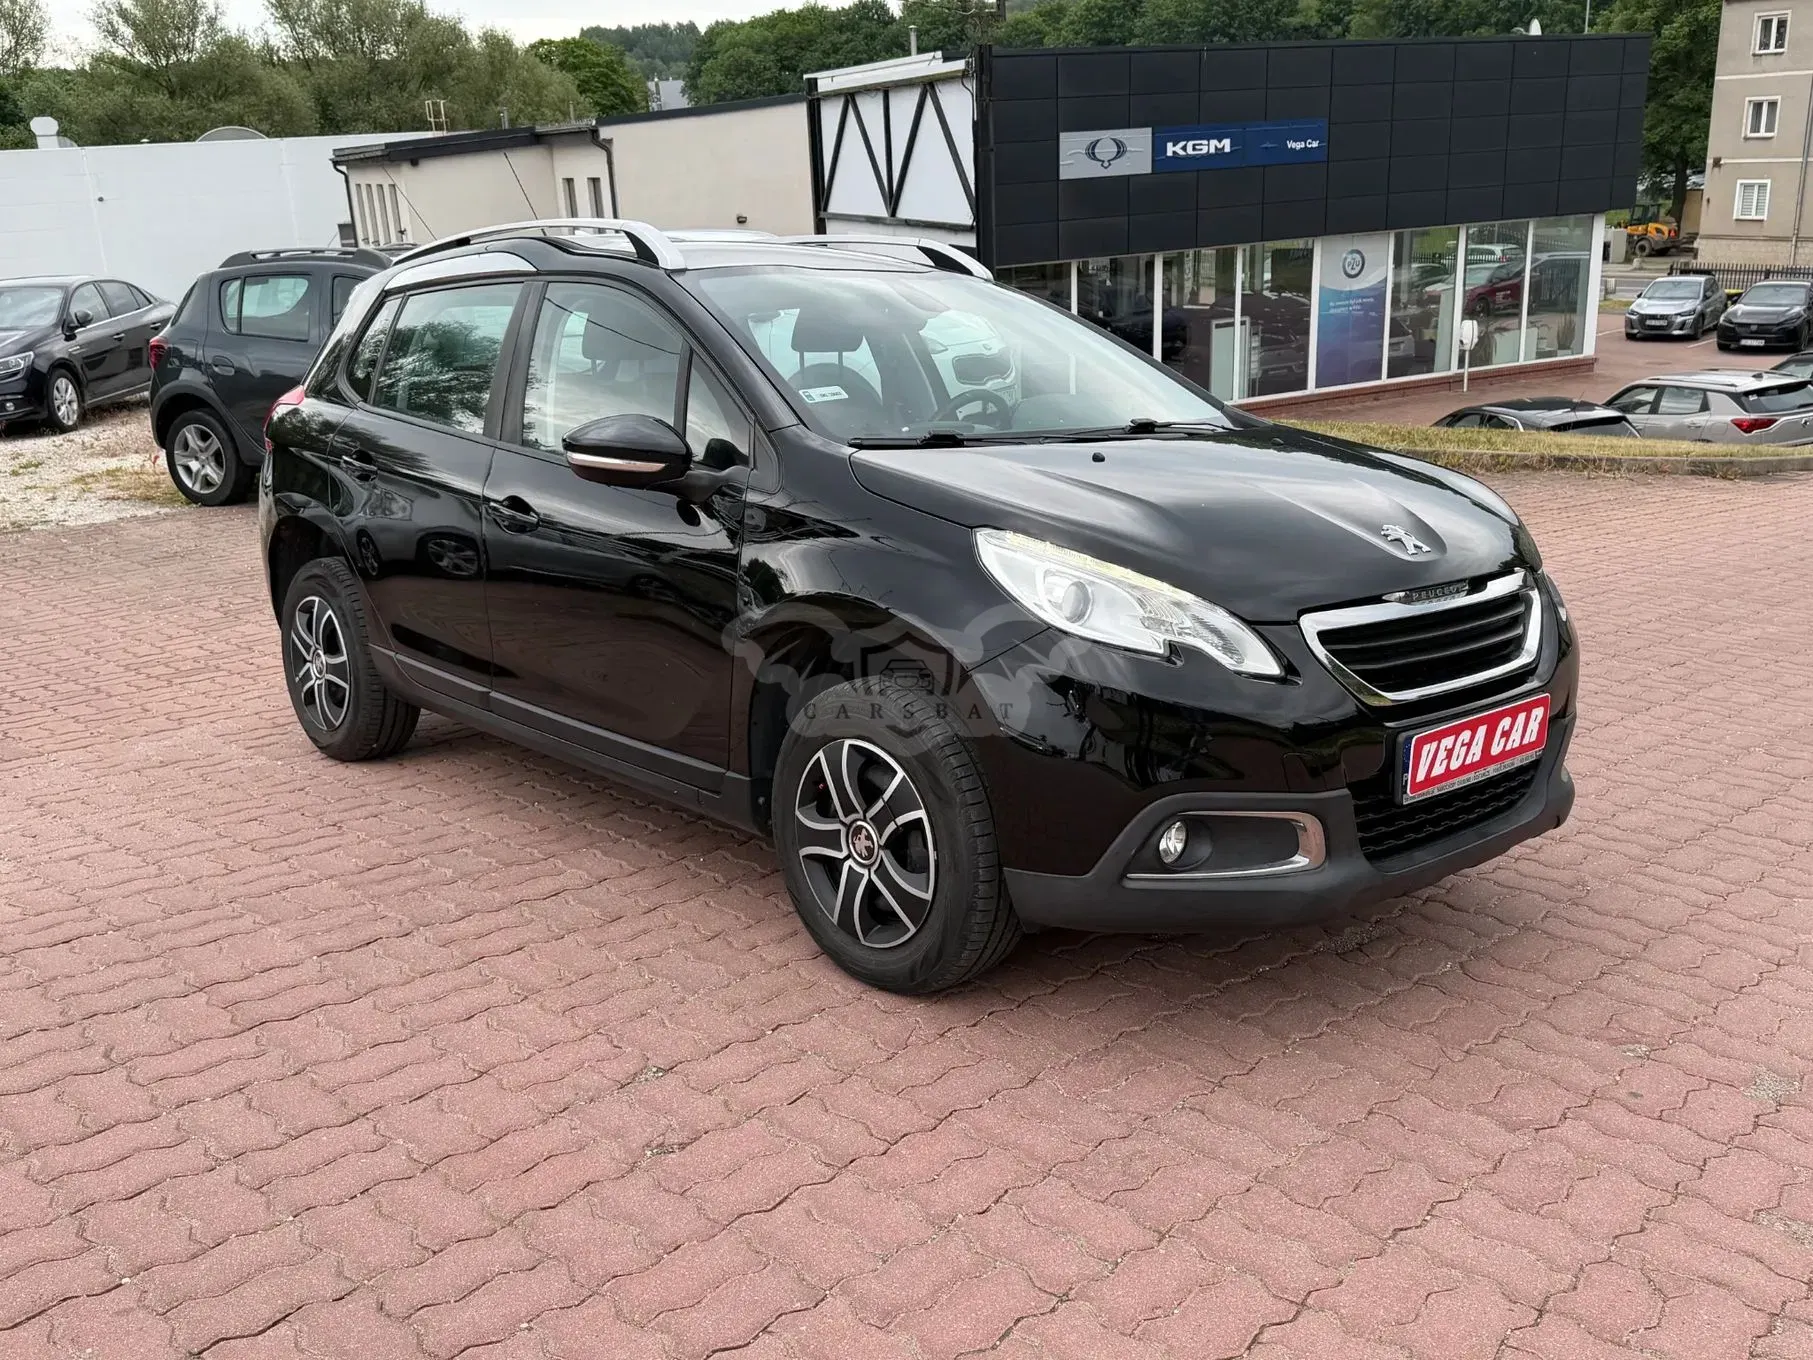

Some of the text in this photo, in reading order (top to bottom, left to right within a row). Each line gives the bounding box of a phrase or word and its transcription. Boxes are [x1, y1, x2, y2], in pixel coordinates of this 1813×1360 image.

[1167, 138, 1230, 156] KGM
[1287, 139, 1319, 150] Vega Car
[1347, 257, 1360, 270] PZU
[1412, 584, 1463, 600] PEUGEOT
[1415, 725, 1488, 783] VEGA
[1491, 706, 1544, 756] CAR
